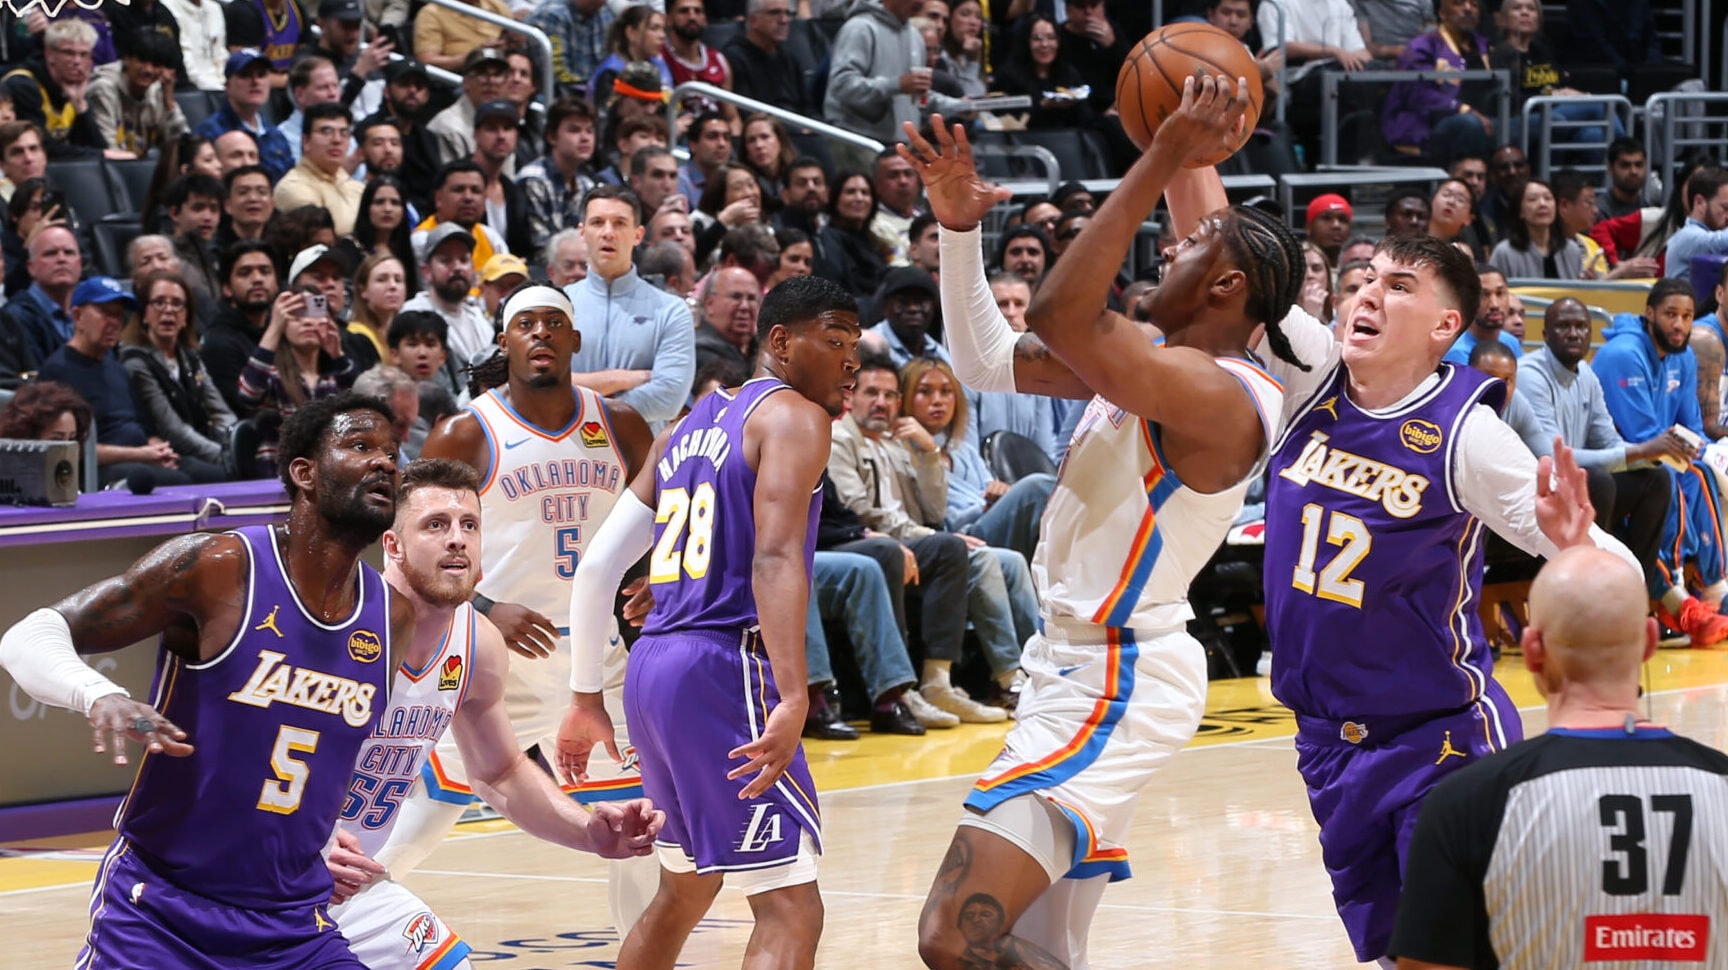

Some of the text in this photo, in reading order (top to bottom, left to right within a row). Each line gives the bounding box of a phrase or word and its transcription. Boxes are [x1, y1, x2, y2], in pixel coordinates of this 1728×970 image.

[1404, 424, 1439, 445] bibigo
[499, 459, 620, 501] OKLAHOMA
[1279, 430, 1430, 518] LAKERS
[541, 492, 591, 523] CITY
[649, 481, 716, 584] 28
[554, 525, 582, 580] 5
[1292, 503, 1372, 609] 12
[351, 638, 379, 654] bibigo
[227, 649, 377, 727] LAKERS
[370, 705, 454, 742] LAHOM
[256, 724, 320, 815] 5
[360, 744, 422, 775] CITY
[340, 770, 415, 830] 55
[733, 803, 784, 852] LA
[1599, 794, 1693, 895] 37
[1595, 925, 1696, 948] Emirates
